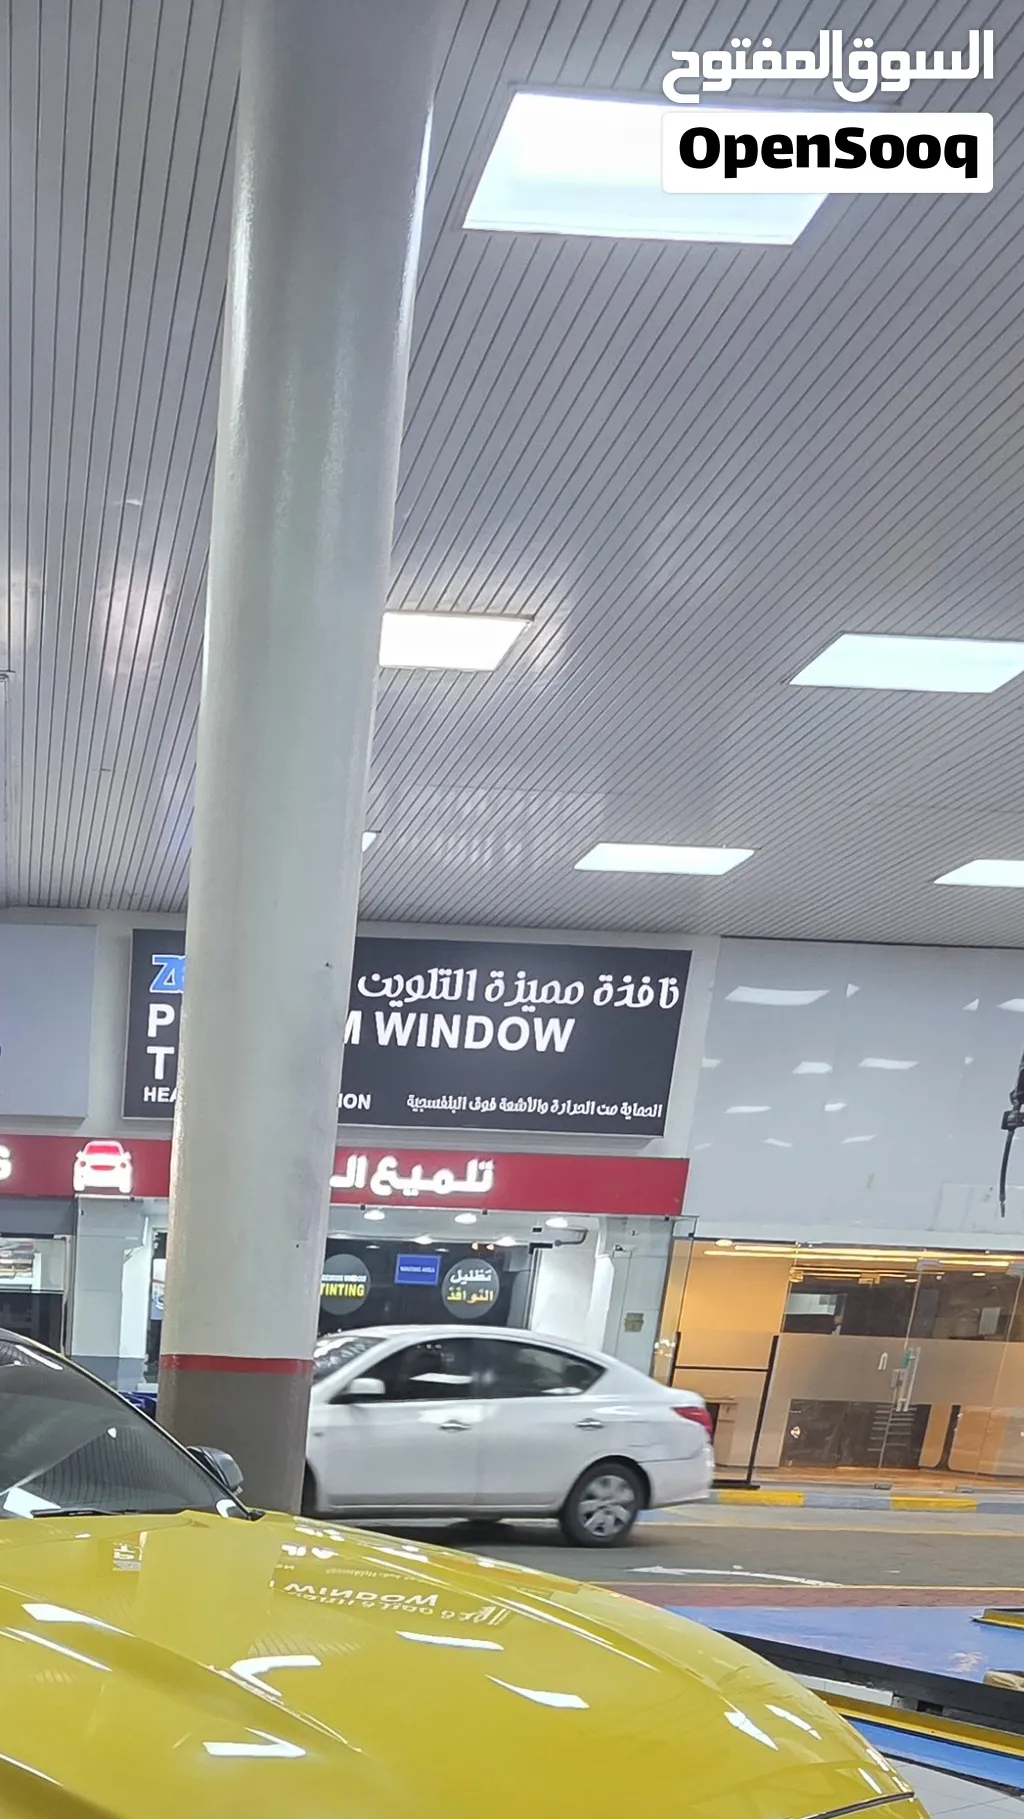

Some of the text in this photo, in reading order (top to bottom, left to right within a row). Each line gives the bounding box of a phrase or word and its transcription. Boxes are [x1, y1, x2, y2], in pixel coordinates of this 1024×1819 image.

[357, 967, 680, 1013] نافذة مميزة التلوين
[375, 1011, 576, 1053] WINDOW
[406, 1093, 467, 1114] البنفسجية
[468, 1096, 497, 1113] فوق
[550, 1098, 596, 1116] الحرارة
[596, 1103, 618, 1117] من
[620, 1101, 663, 1120] الحماية
[370, 1154, 495, 1197] تلميع
[449, 1268, 493, 1286] تظليل
[320, 1283, 366, 1297] TINTING
[446, 1286, 494, 1304] النوافذ
